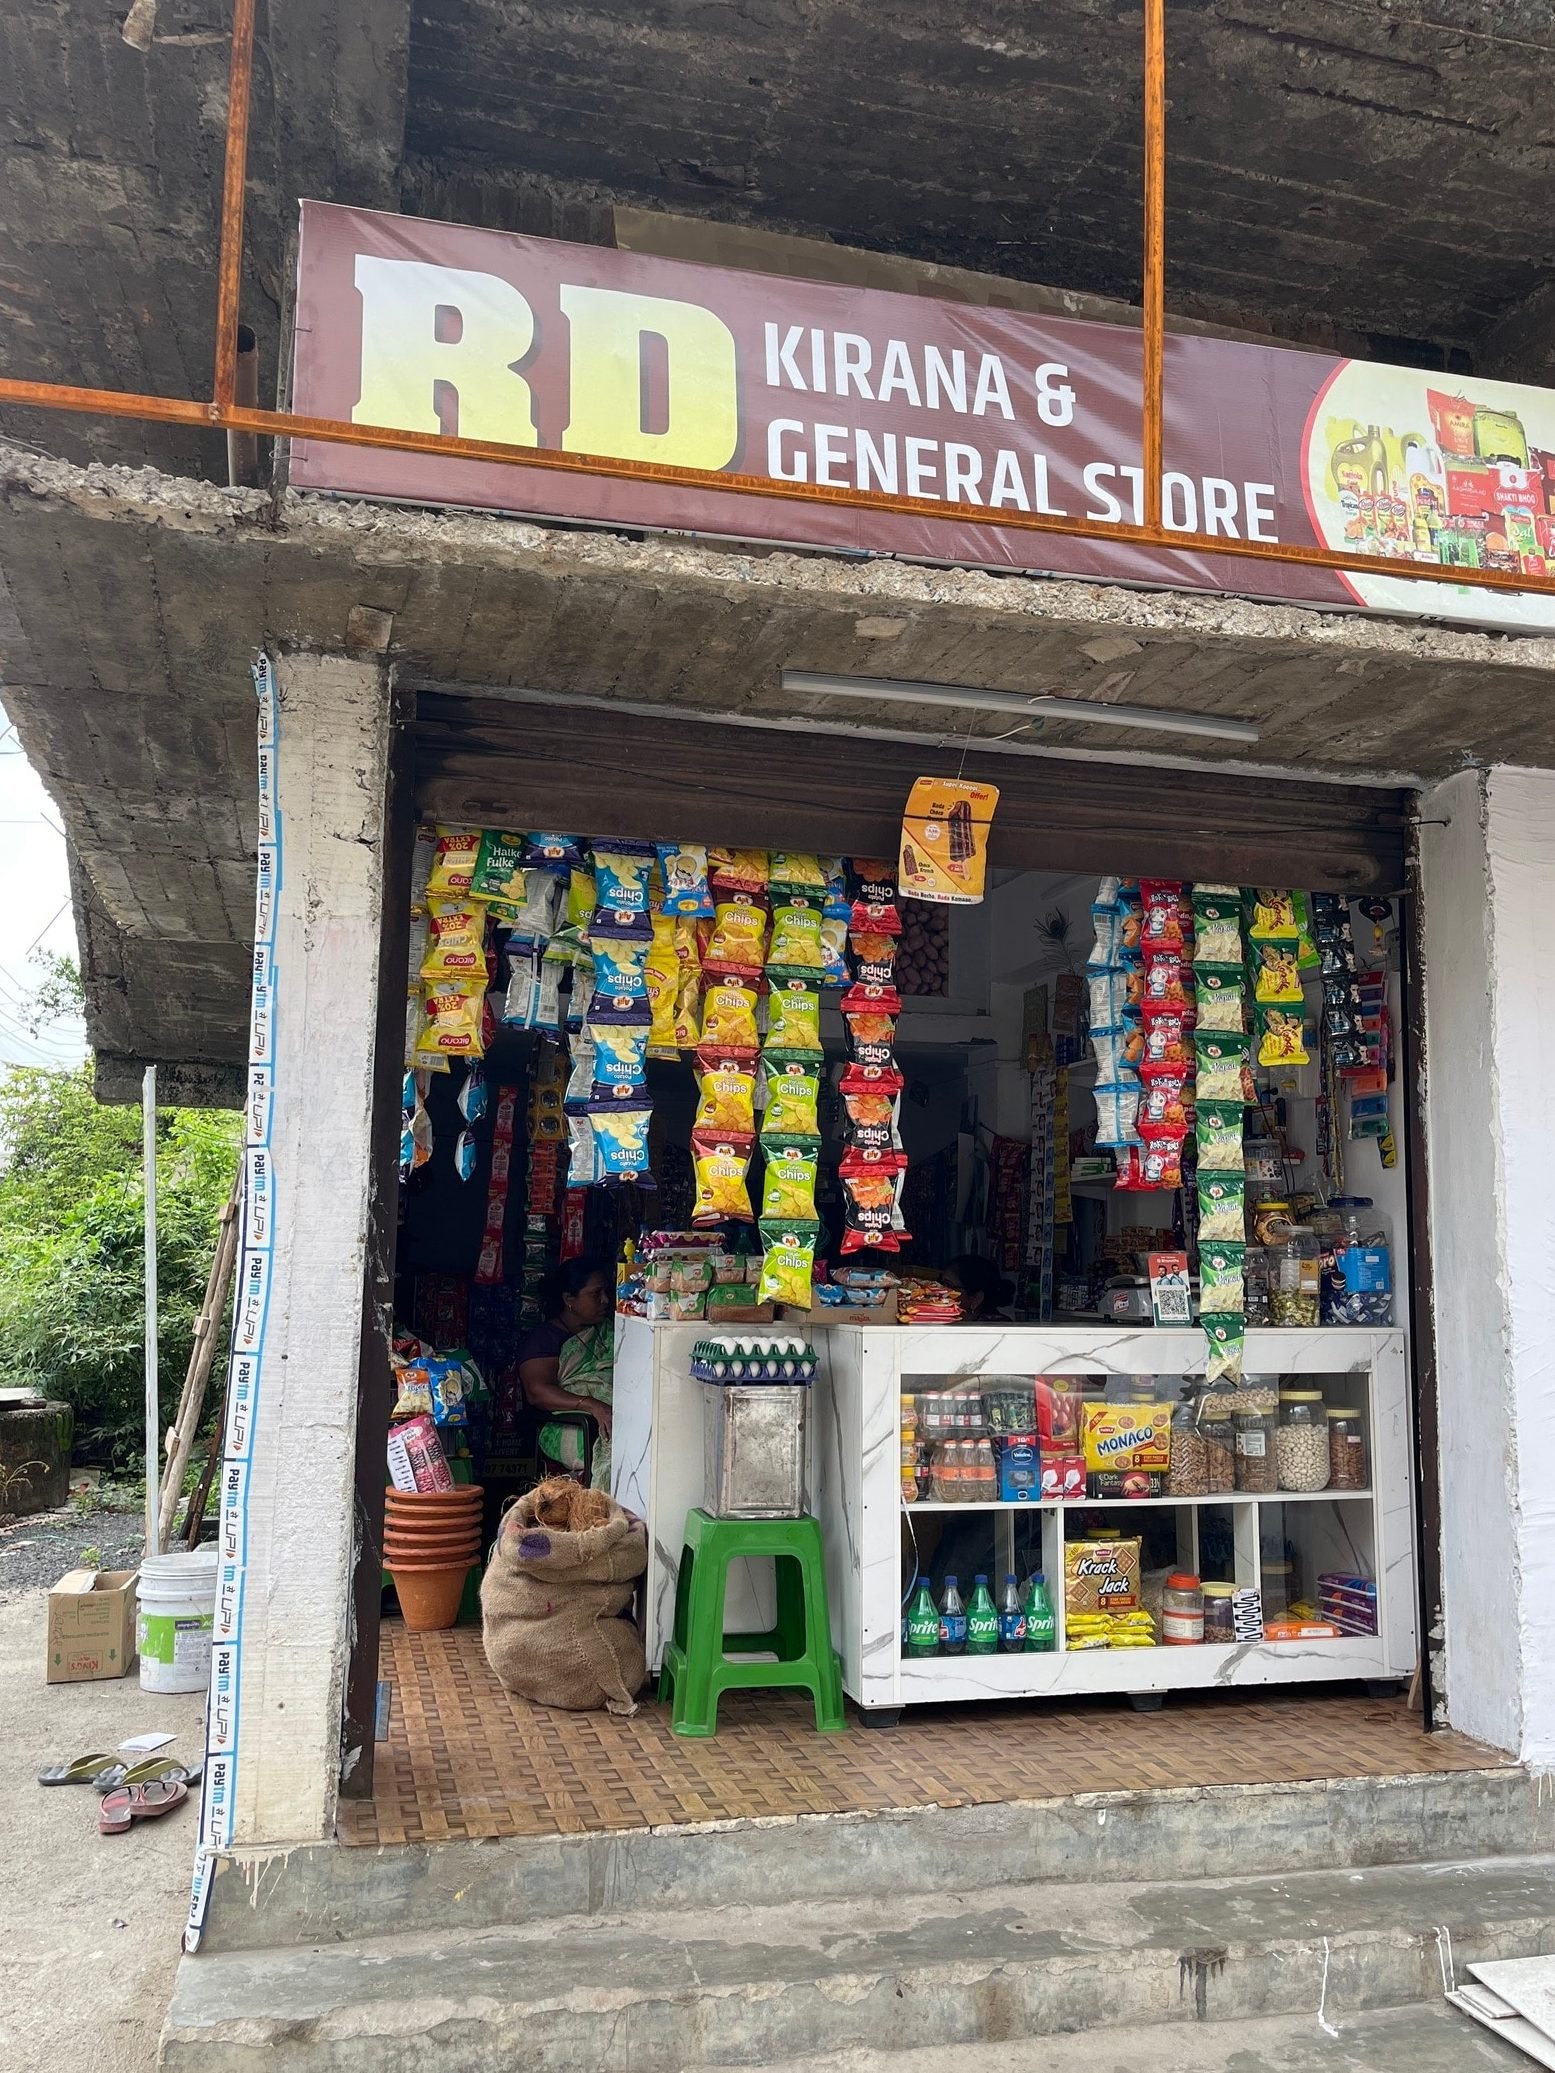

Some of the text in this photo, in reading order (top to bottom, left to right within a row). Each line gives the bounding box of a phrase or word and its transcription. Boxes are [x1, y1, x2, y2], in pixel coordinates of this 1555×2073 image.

[352, 254, 737, 471] RD
[764, 321, 1076, 428] KIRANA &
[767, 418, 1279, 544] GENERAL STORE
[970, 792, 989, 800] Offer!
[449, 842, 469, 850] 20%
[487, 857, 514, 867] Fulke
[260, 853, 271, 888] paytm
[609, 887, 643, 901] Chips
[861, 884, 893, 897] Chips
[437, 914, 464, 923] EXTRA
[725, 912, 758, 926] Chips
[784, 914, 817, 929] Chips
[443, 921, 462, 930] 20%
[860, 964, 892, 977] Chips
[607, 974, 642, 987] Chips
[432, 995, 459, 1004] EXTRA
[715, 994, 750, 1008] Chips
[782, 999, 815, 1013] Chips
[439, 1003, 458, 1012] 20%
[858, 1045, 890, 1058] Chips
[606, 1063, 642, 1075] Chips
[713, 1082, 746, 1094] Chips
[780, 1083, 812, 1097] Chips
[857, 1129, 889, 1141] Chips
[610, 1149, 645, 1161] Chips
[254, 1154, 267, 1191] paytm
[709, 1165, 743, 1178] Chips
[777, 1169, 811, 1183] Chips
[857, 1212, 890, 1224] Chips
[777, 1255, 808, 1268] Chips
[248, 1258, 262, 1295] paytm
[236, 1362, 250, 1400] paytm
[1097, 1427, 1153, 1456] MONACO
[1134, 1455, 1140, 1463] 8
[227, 1469, 240, 1507] paytm
[1078, 1559, 1116, 1575] Krack
[1098, 1578, 1129, 1594] Jack
[1100, 1598, 1106, 1606] 8
[218, 1652, 231, 1691] paytm
[211, 1763, 226, 1804] paytm
